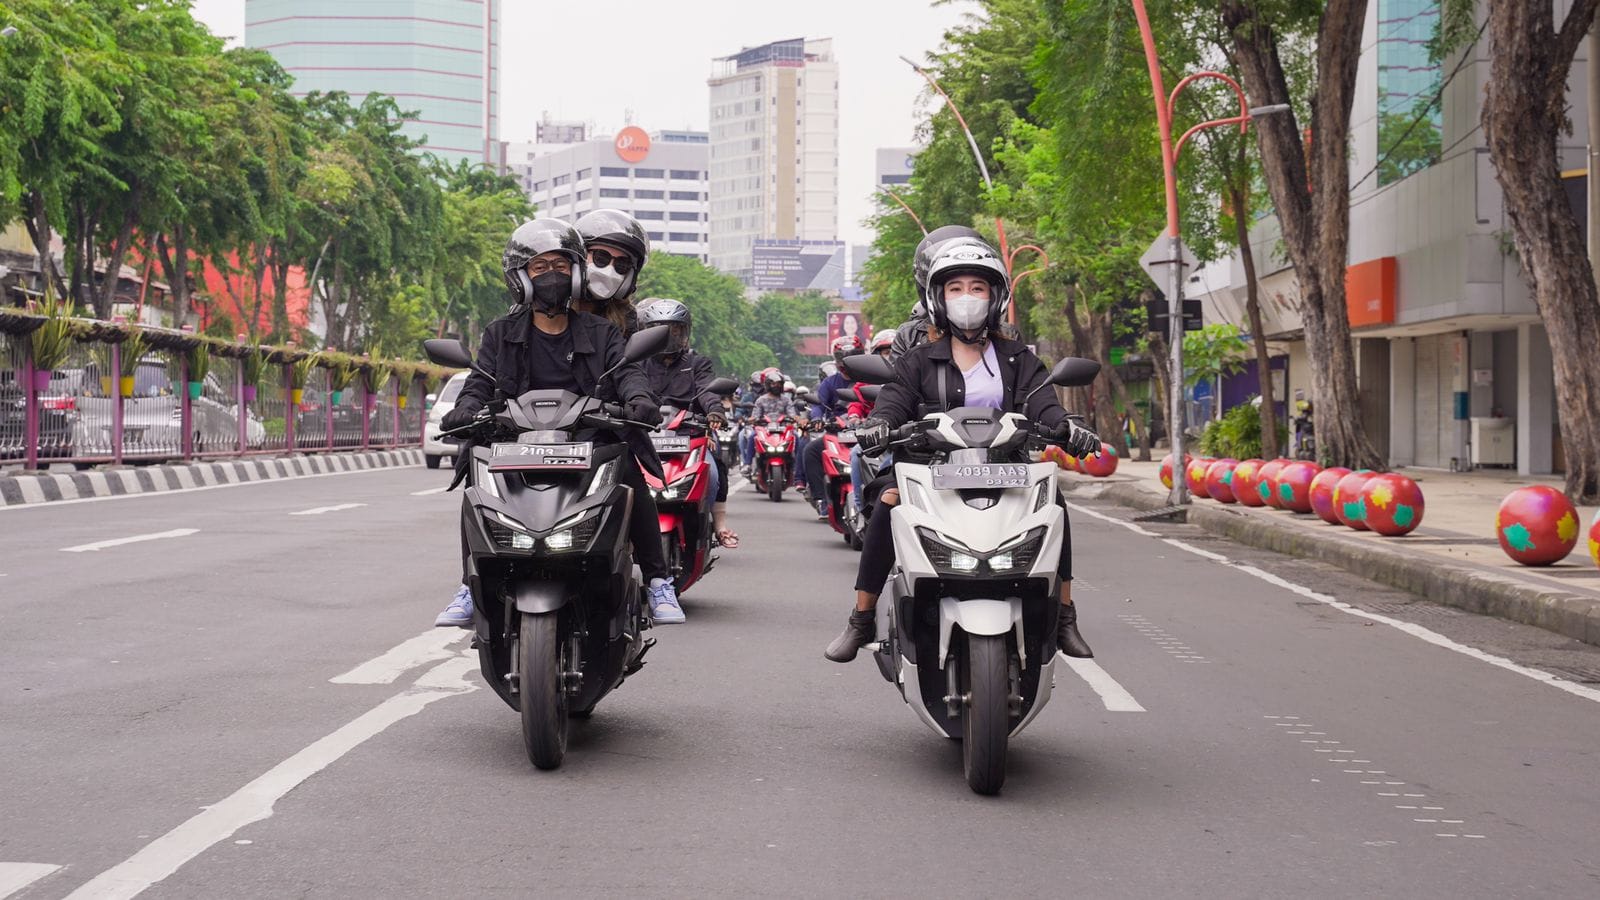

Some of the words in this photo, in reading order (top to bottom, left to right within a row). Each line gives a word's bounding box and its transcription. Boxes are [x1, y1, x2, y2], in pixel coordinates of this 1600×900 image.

[935, 466, 943, 477] L
[955, 466, 991, 477] 4039
[998, 465, 1027, 477] AAS
